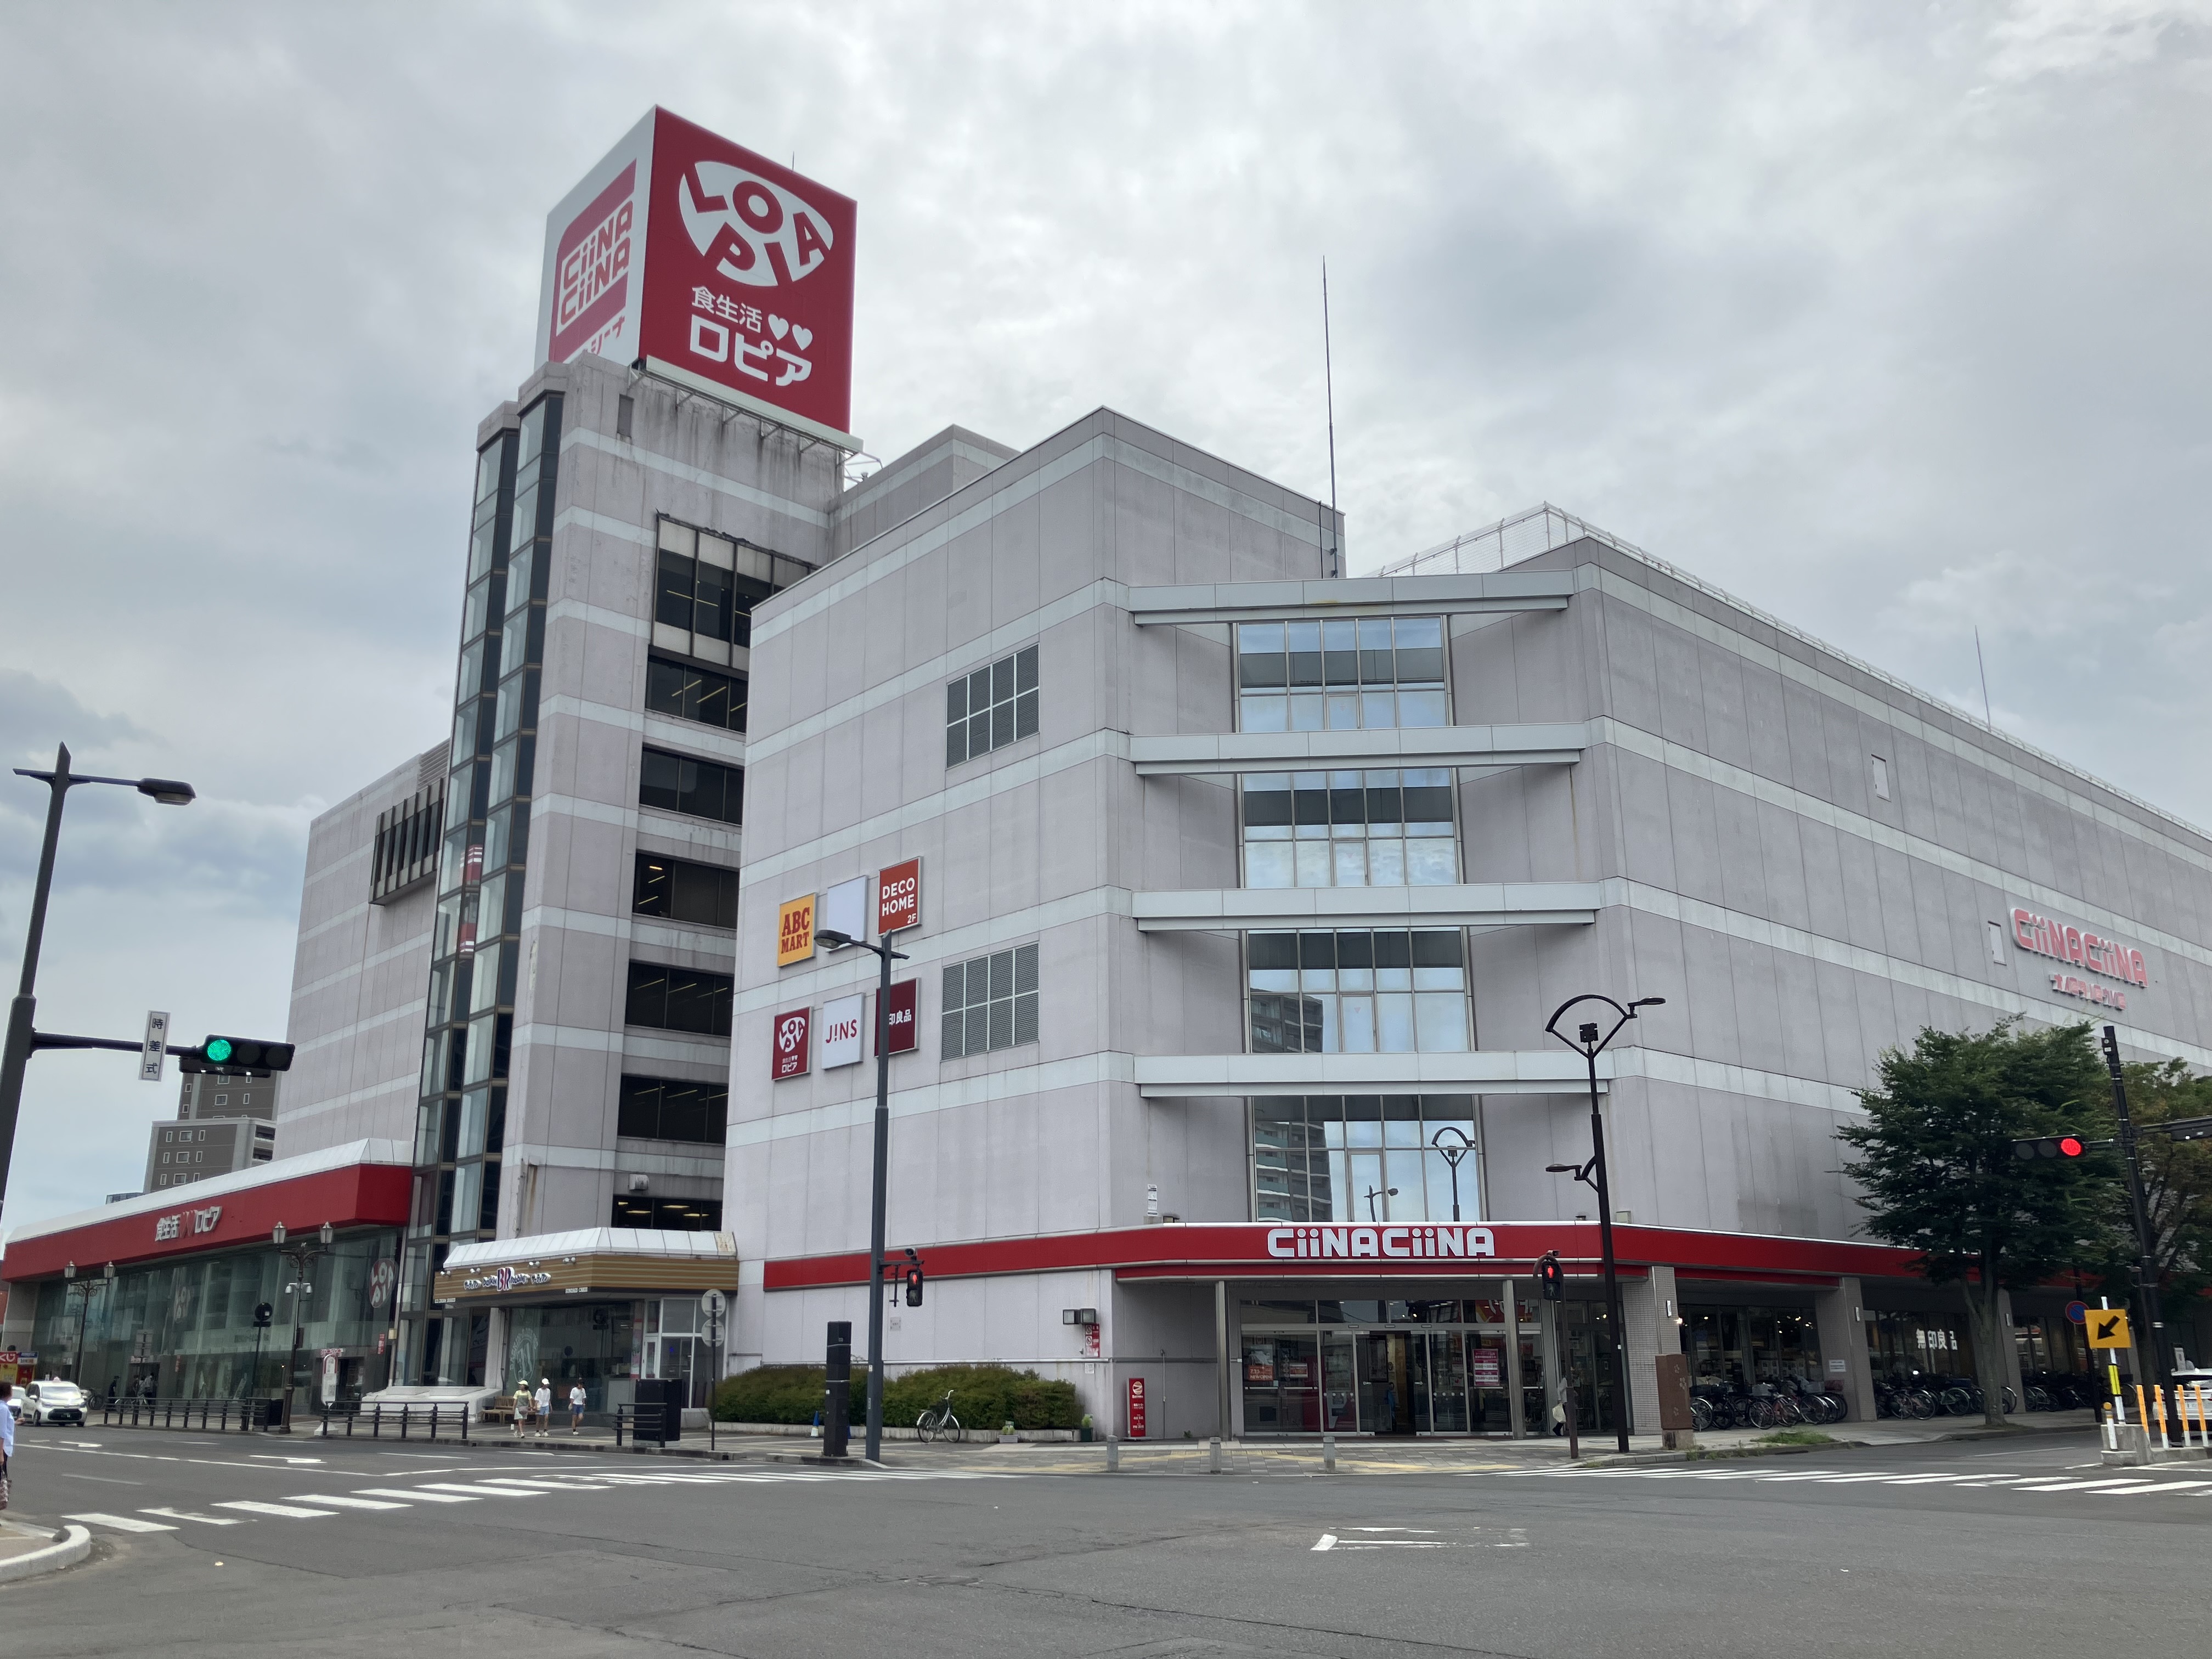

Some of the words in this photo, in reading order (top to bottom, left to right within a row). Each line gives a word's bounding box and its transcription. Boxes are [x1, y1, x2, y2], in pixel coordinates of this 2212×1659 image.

[691, 286, 763, 334] 食生活
[690, 314, 812, 386] ロピア
[882, 877, 915, 900] DECO
[882, 893, 915, 917] HOME
[782, 906, 810, 937] ABC
[907, 913, 917, 924] 2F
[781, 932, 810, 954] MART
[889, 1008, 912, 1025] 印良品
[145, 1018, 164, 1074] 時差式
[781, 1062, 798, 1074] ロピア
[155, 1214, 181, 1242] 食生活
[195, 1206, 222, 1233] ロピア
[1916, 1328, 1958, 1350] 無印良品
